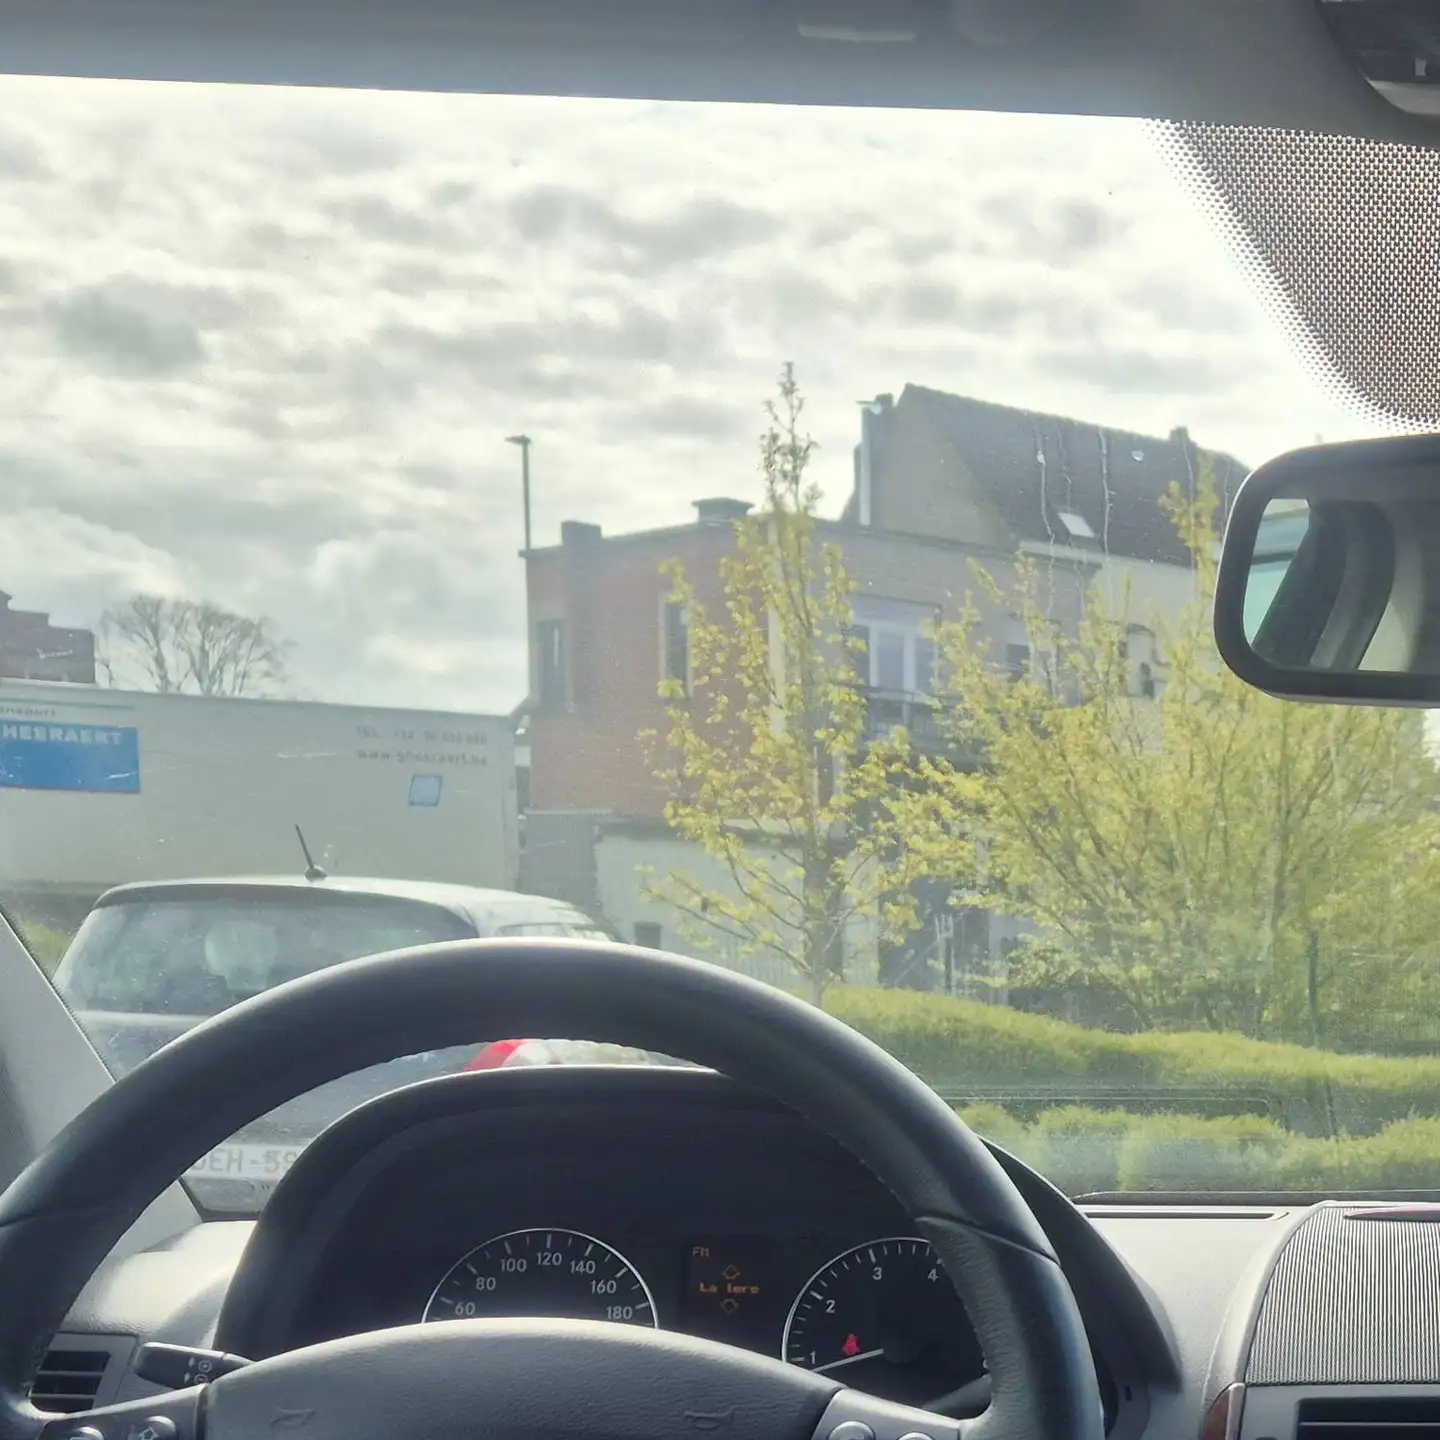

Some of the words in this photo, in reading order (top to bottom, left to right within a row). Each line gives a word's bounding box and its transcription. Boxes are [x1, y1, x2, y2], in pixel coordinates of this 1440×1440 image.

[455, 1301, 476, 1316] 60
[476, 1276, 497, 1292] 80
[501, 1258, 527, 1273] 100
[536, 1252, 563, 1266] 120
[570, 1260, 596, 1275] 140
[591, 1280, 617, 1295] 160
[606, 1305, 633, 1320] 180
[809, 1350, 817, 1365] 1
[825, 1299, 836, 1314] 2
[872, 1266, 883, 1281] 3
[927, 1267, 939, 1281] 4
